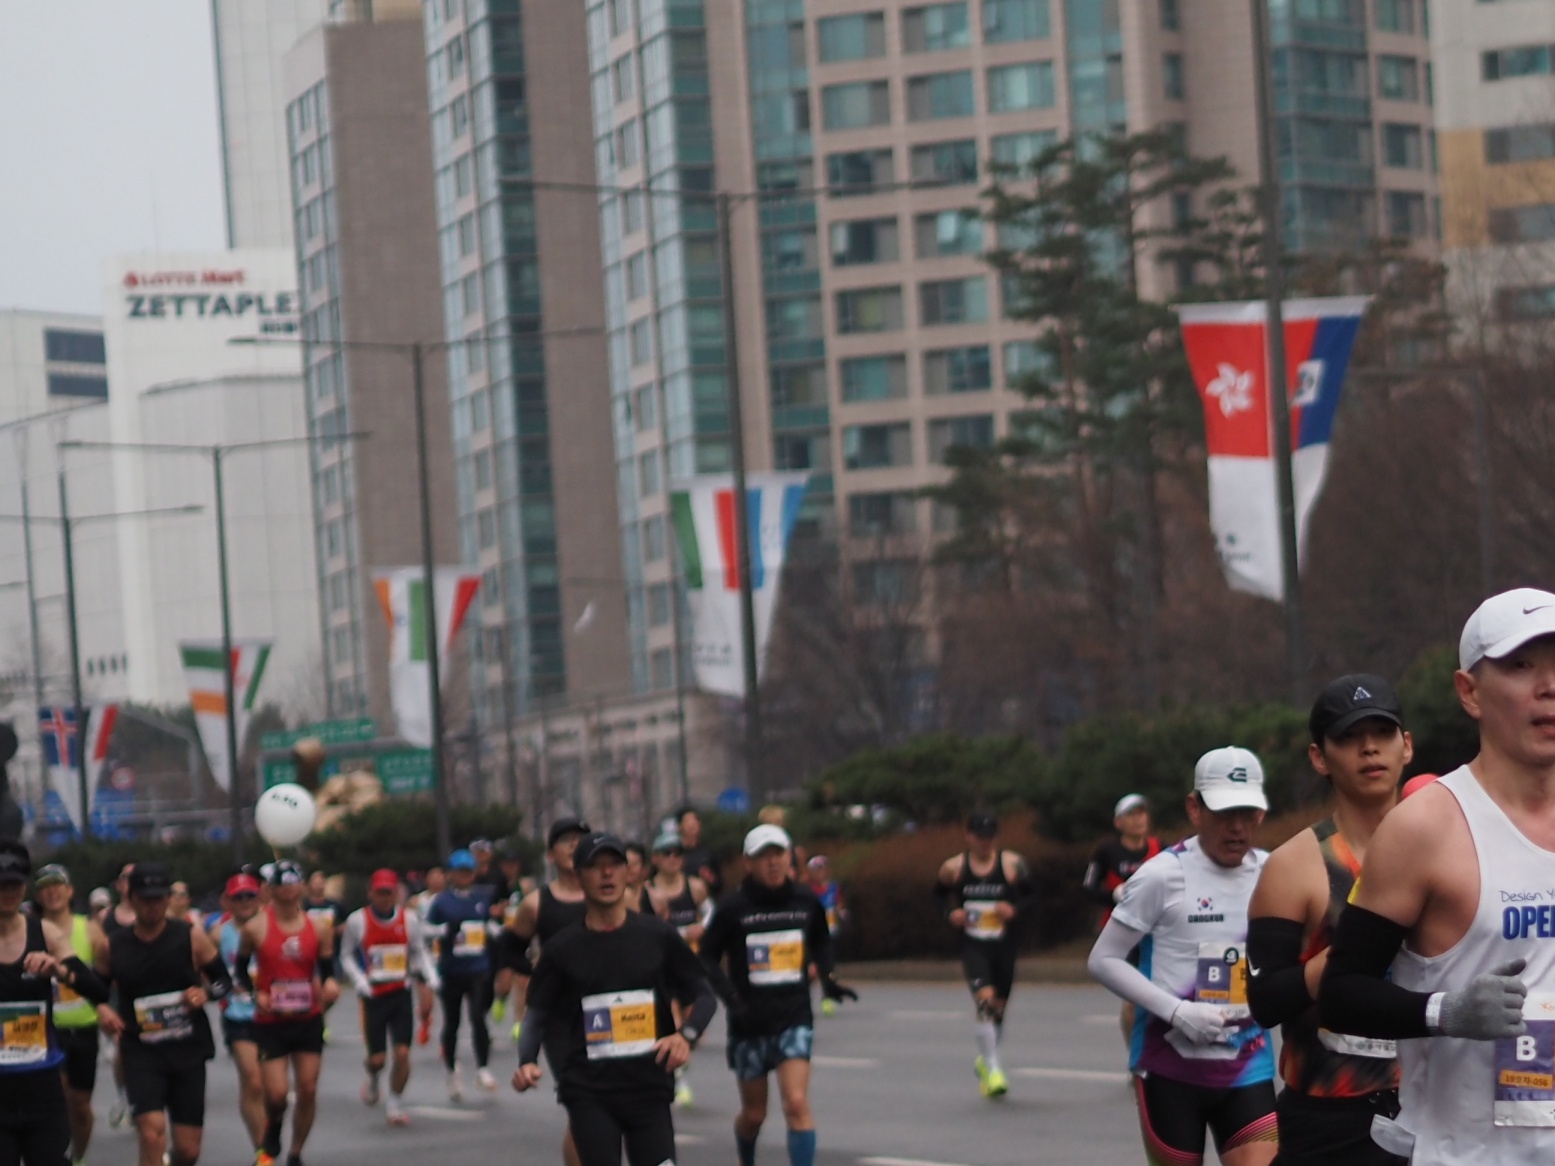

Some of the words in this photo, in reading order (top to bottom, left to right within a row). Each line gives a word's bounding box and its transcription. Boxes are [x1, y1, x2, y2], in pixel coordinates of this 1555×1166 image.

[127, 292, 300, 317] ZETTAPLE
[1499, 890, 1543, 902] Design
[1208, 966, 1220, 982] B
[1516, 1035, 1537, 1061] B
